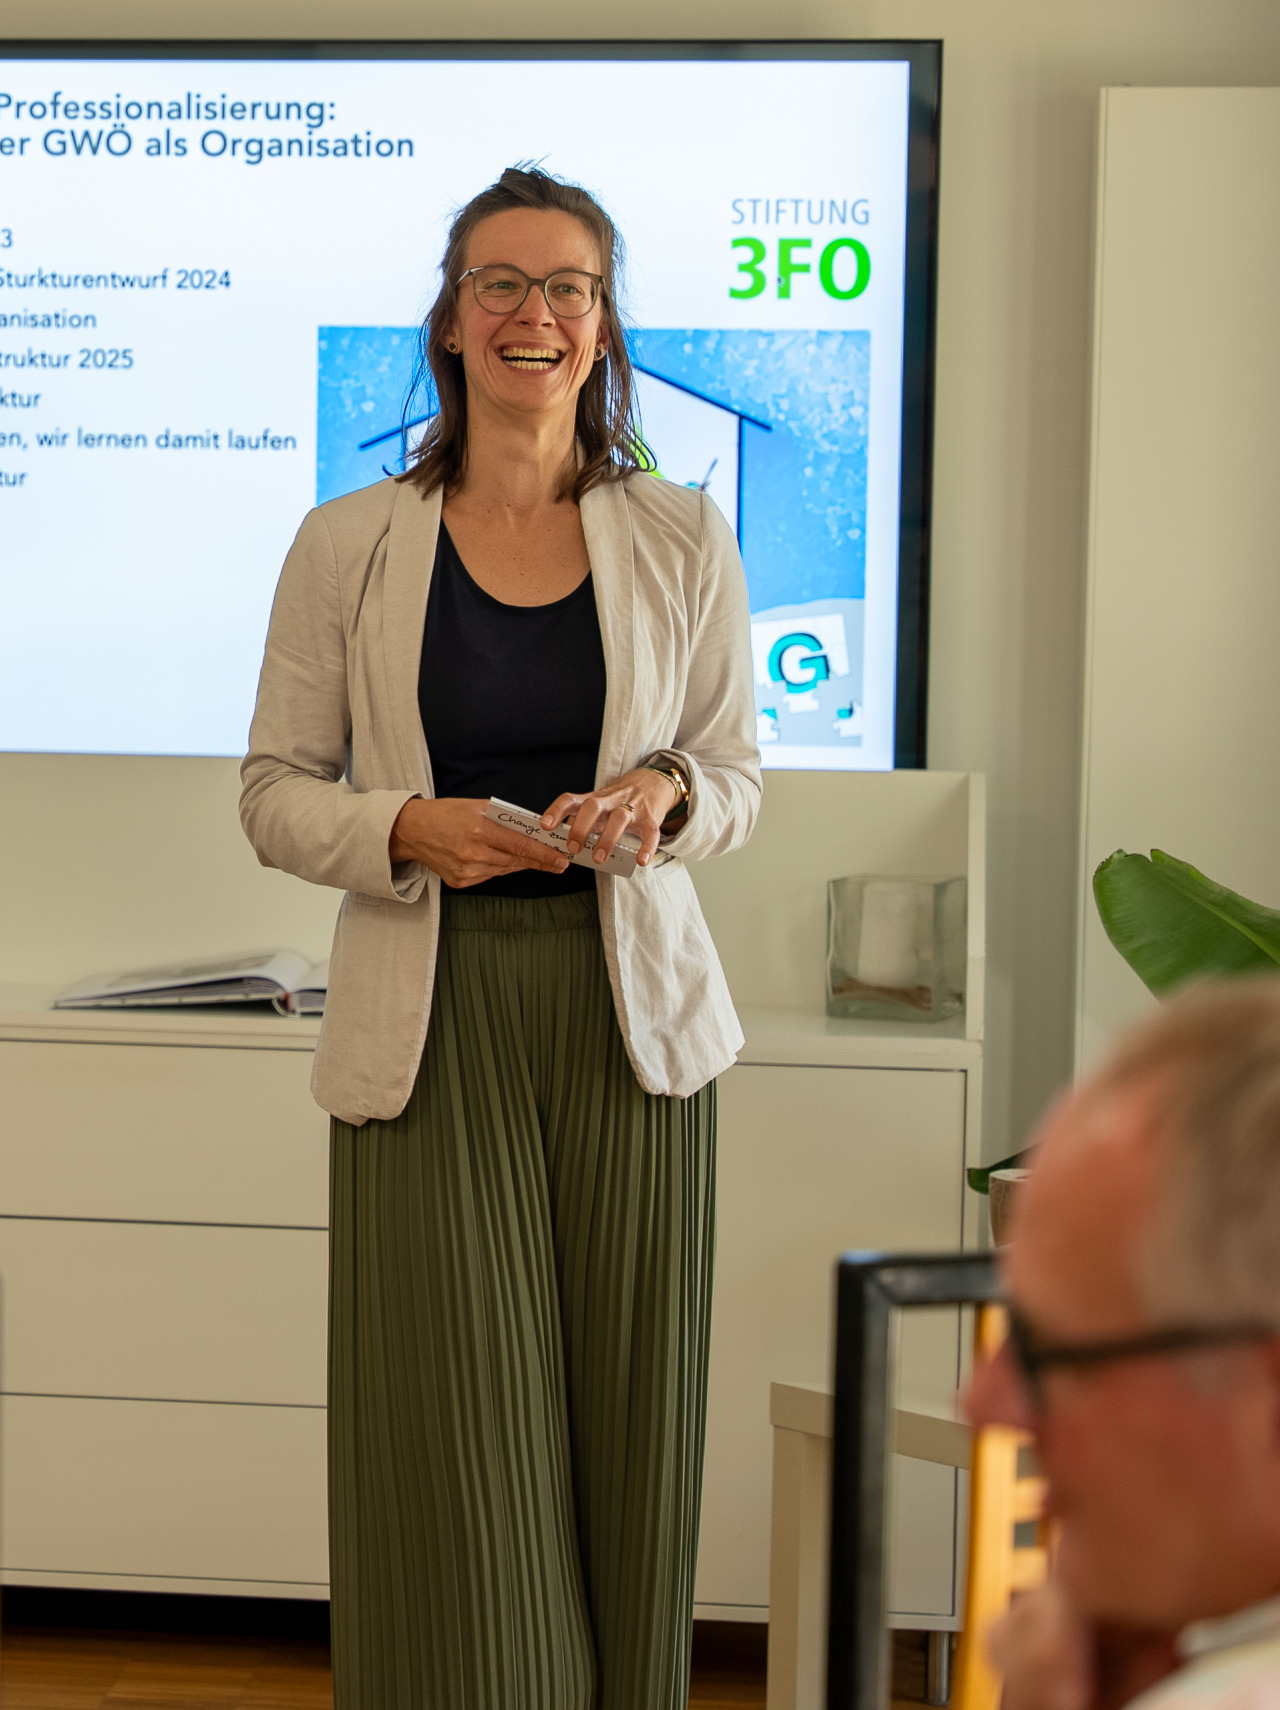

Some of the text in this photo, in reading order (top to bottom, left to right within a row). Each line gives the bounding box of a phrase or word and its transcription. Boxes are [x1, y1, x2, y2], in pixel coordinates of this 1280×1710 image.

[42, 128, 133, 157] GWÖ
[144, 128, 189, 157] als
[200, 129, 414, 166] Organisation
[731, 198, 870, 225] STIFTUNG
[175, 268, 232, 290] 2024
[729, 236, 871, 300] 3FO
[78, 348, 134, 370] 2025
[36, 427, 70, 448] wir
[77, 426, 148, 449] lernen
[155, 427, 221, 450] damit
[228, 428, 297, 451] laufen
[768, 632, 830, 694] G
[497, 813, 541, 836] Change
